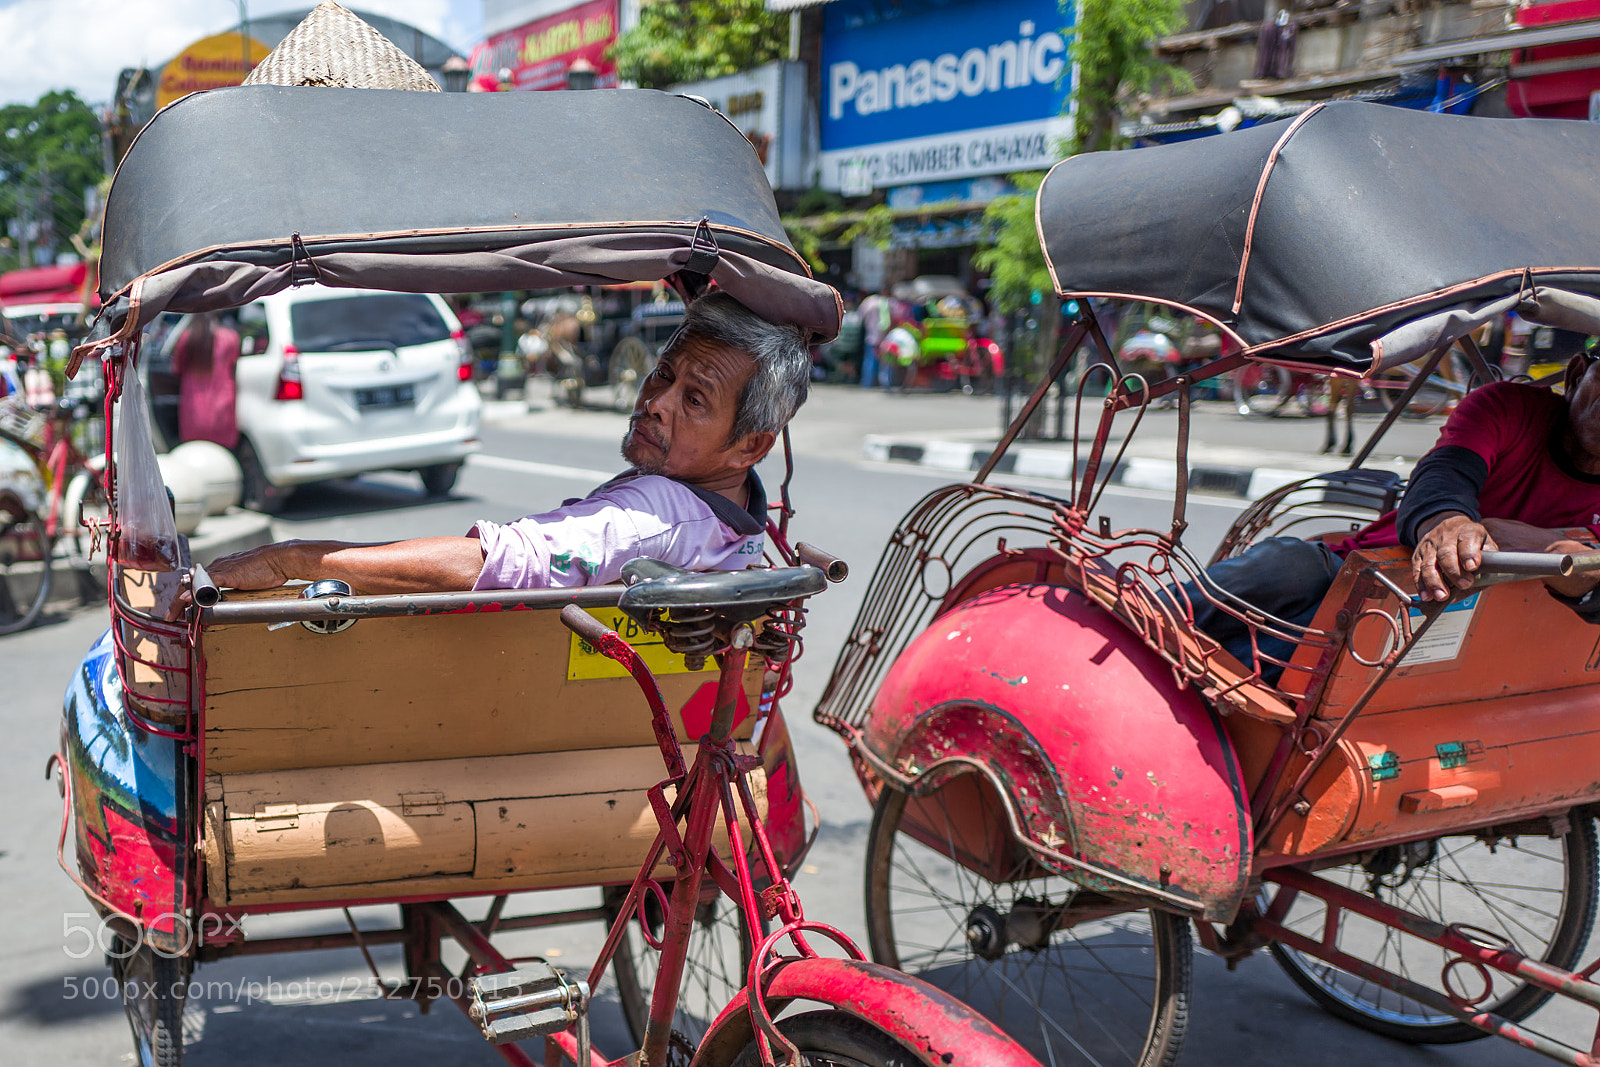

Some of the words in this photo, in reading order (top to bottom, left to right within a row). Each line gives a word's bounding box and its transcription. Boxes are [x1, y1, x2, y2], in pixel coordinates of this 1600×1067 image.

[829, 20, 1066, 120] Panasonic
[886, 142, 963, 177] SUMBER
[967, 132, 1047, 168] CAHAYA
